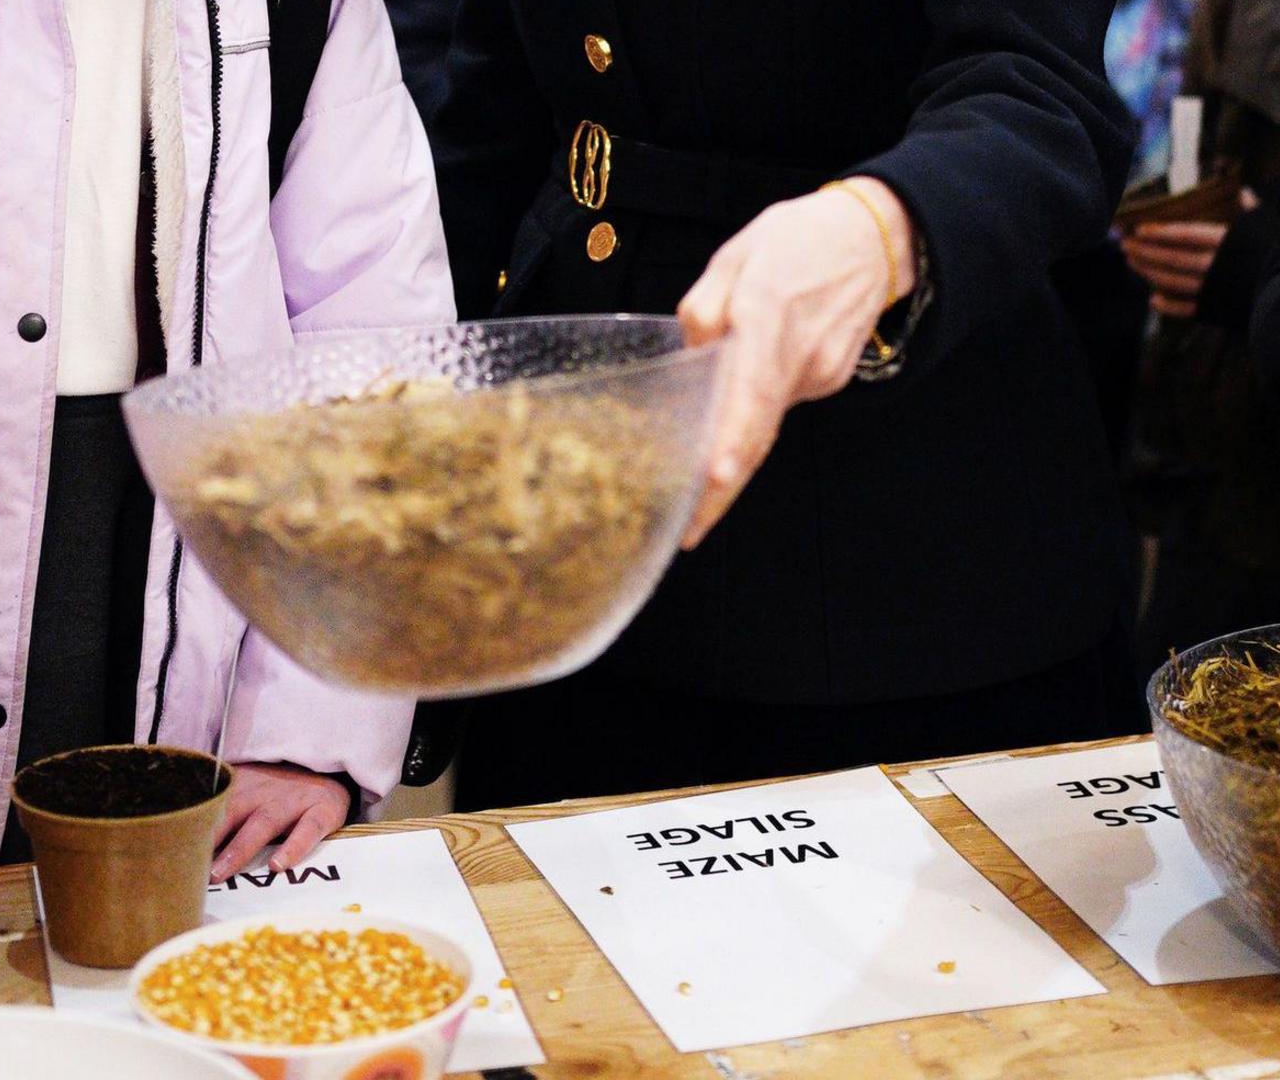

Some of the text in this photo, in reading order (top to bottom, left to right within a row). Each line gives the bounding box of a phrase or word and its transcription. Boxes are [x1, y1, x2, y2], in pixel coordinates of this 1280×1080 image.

[1056, 770, 1165, 799] AGE
[1093, 803, 1181, 827] ASS
[626, 810, 816, 851] SILAGE
[658, 841, 839, 880] MAIZE
[208, 865, 341, 892] MAI
